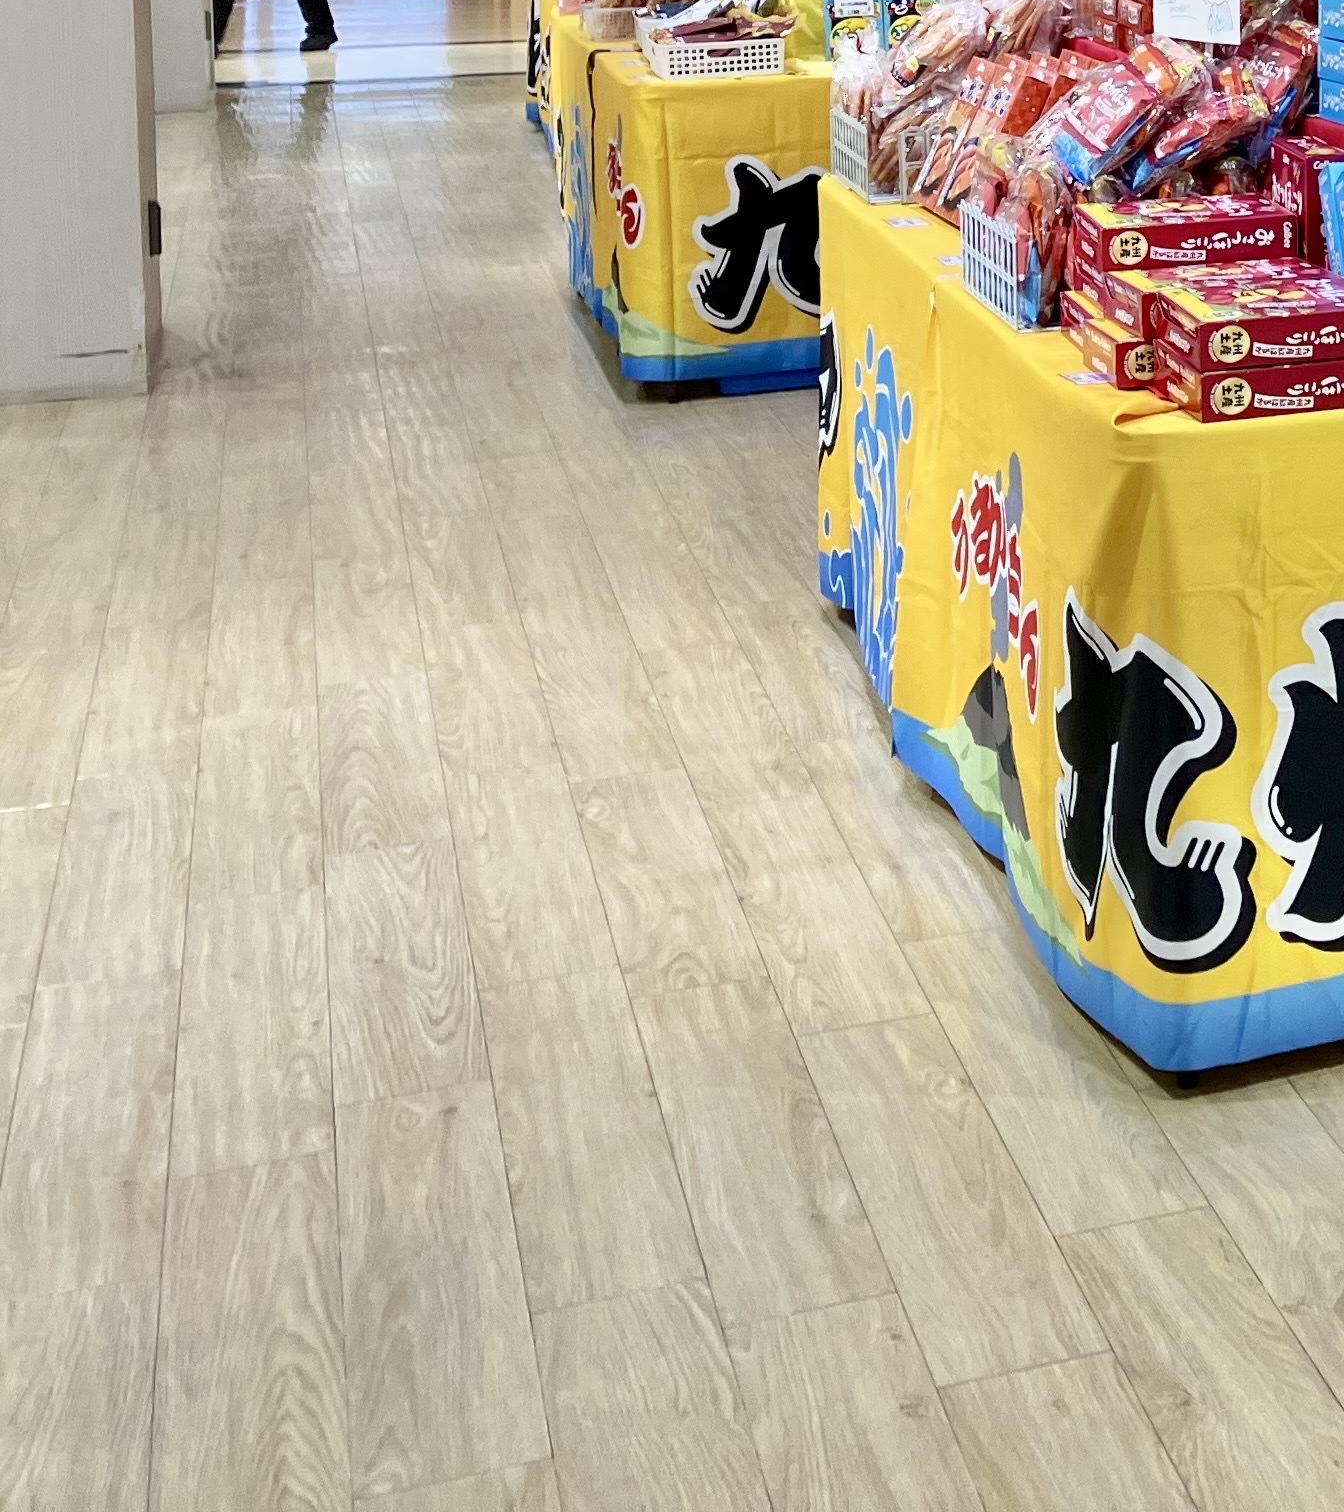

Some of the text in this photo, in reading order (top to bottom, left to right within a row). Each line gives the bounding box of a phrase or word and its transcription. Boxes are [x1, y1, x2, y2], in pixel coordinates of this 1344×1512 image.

[1131, 236, 1142, 258] 九州
[1180, 227, 1276, 250] おさつほっこり
[1219, 332, 1232, 356] 土産
[1232, 331, 1244, 355] 九州
[1221, 383, 1233, 408] 土産
[1233, 383, 1245, 407] 九州
